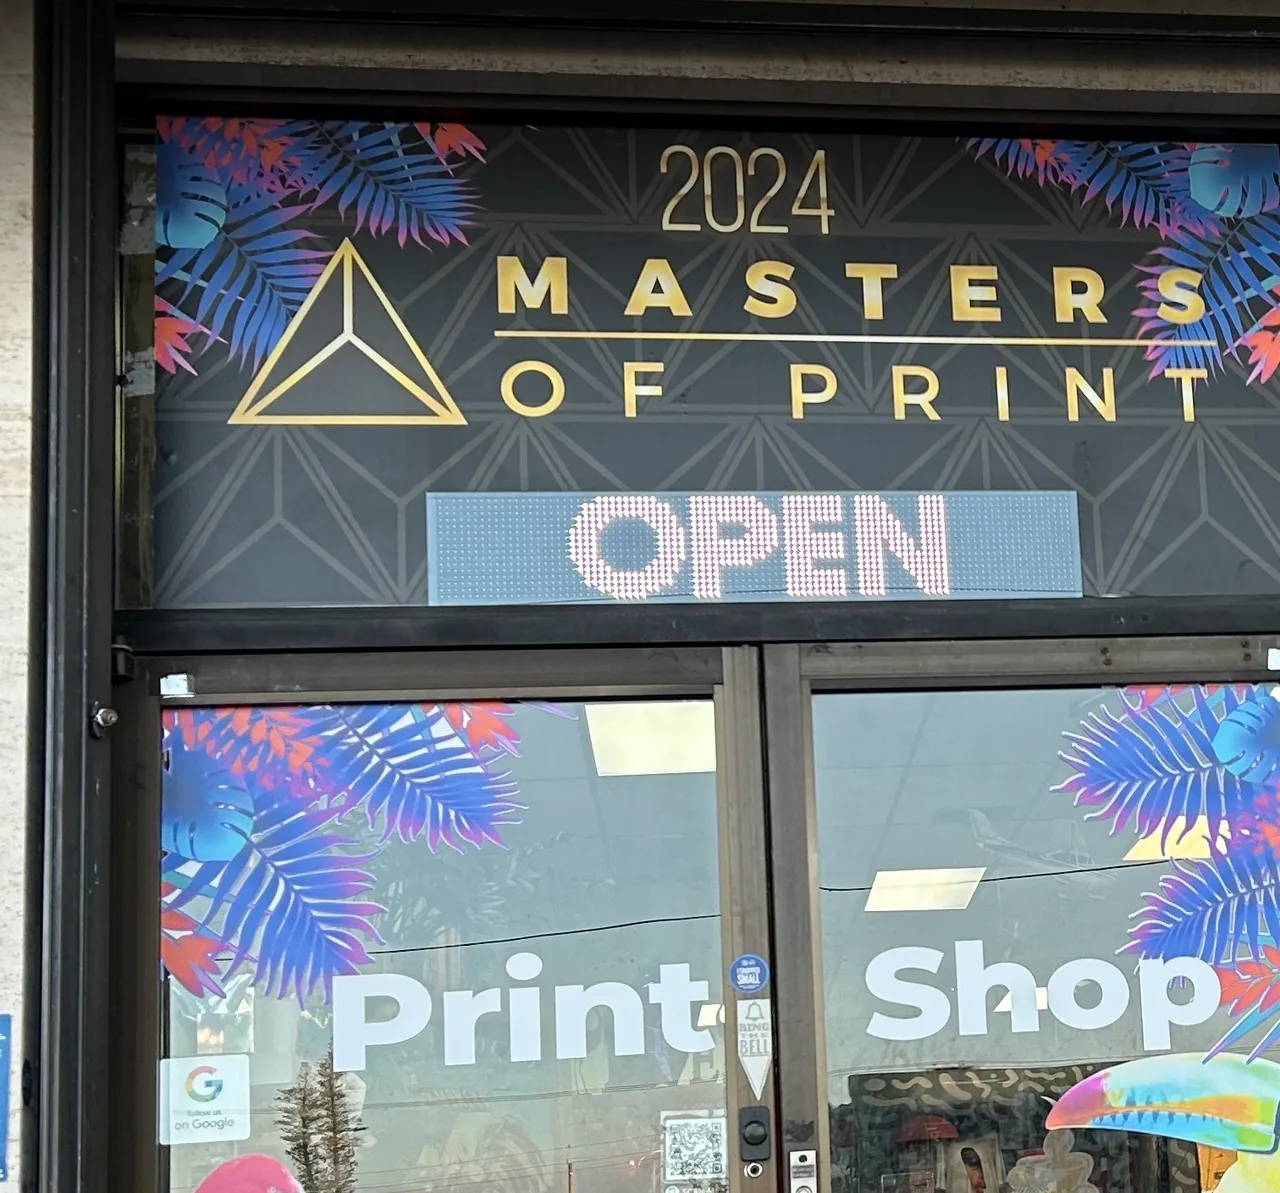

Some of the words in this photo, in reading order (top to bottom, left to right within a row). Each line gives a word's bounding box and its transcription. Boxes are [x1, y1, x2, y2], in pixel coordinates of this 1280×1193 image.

[660, 145, 835, 234] 2024
[496, 256, 1205, 324] MASTERS
[500, 361, 664, 417] OF
[790, 364, 1208, 422] PRINT
[568, 494, 950, 600] OPEN
[332, 953, 716, 1072] Print
[865, 940, 1221, 1050] Shop
[740, 1039, 769, 1055] BELL
[174, 1122, 189, 1130] on
[192, 1118, 235, 1129] Google
